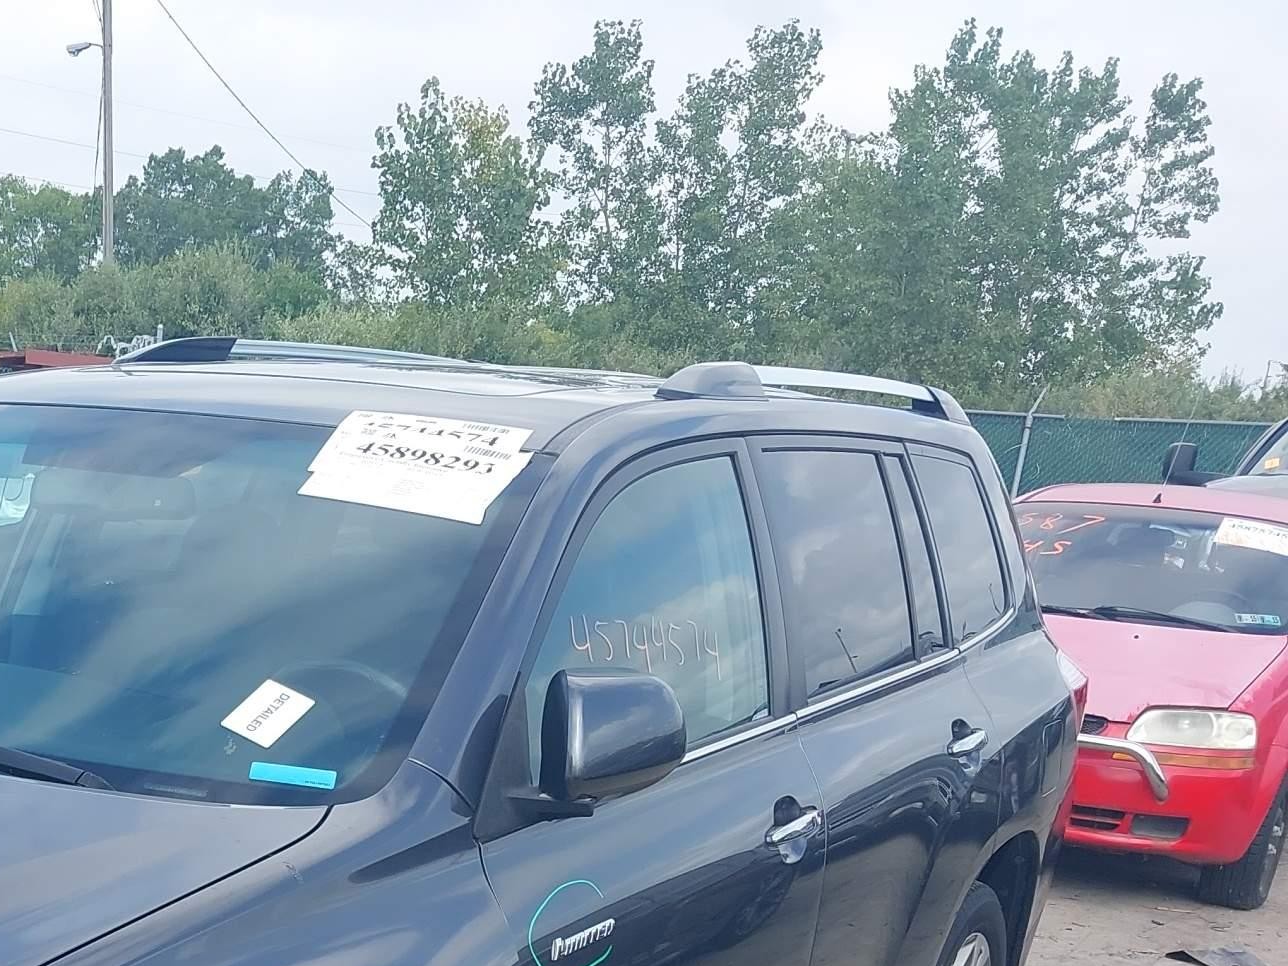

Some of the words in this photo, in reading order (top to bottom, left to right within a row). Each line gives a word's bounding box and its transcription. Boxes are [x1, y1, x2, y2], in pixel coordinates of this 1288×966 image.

[357, 441, 496, 475] 45898293
[570, 614, 722, 681] 45744574
[246, 692, 291, 733] DETAILED
